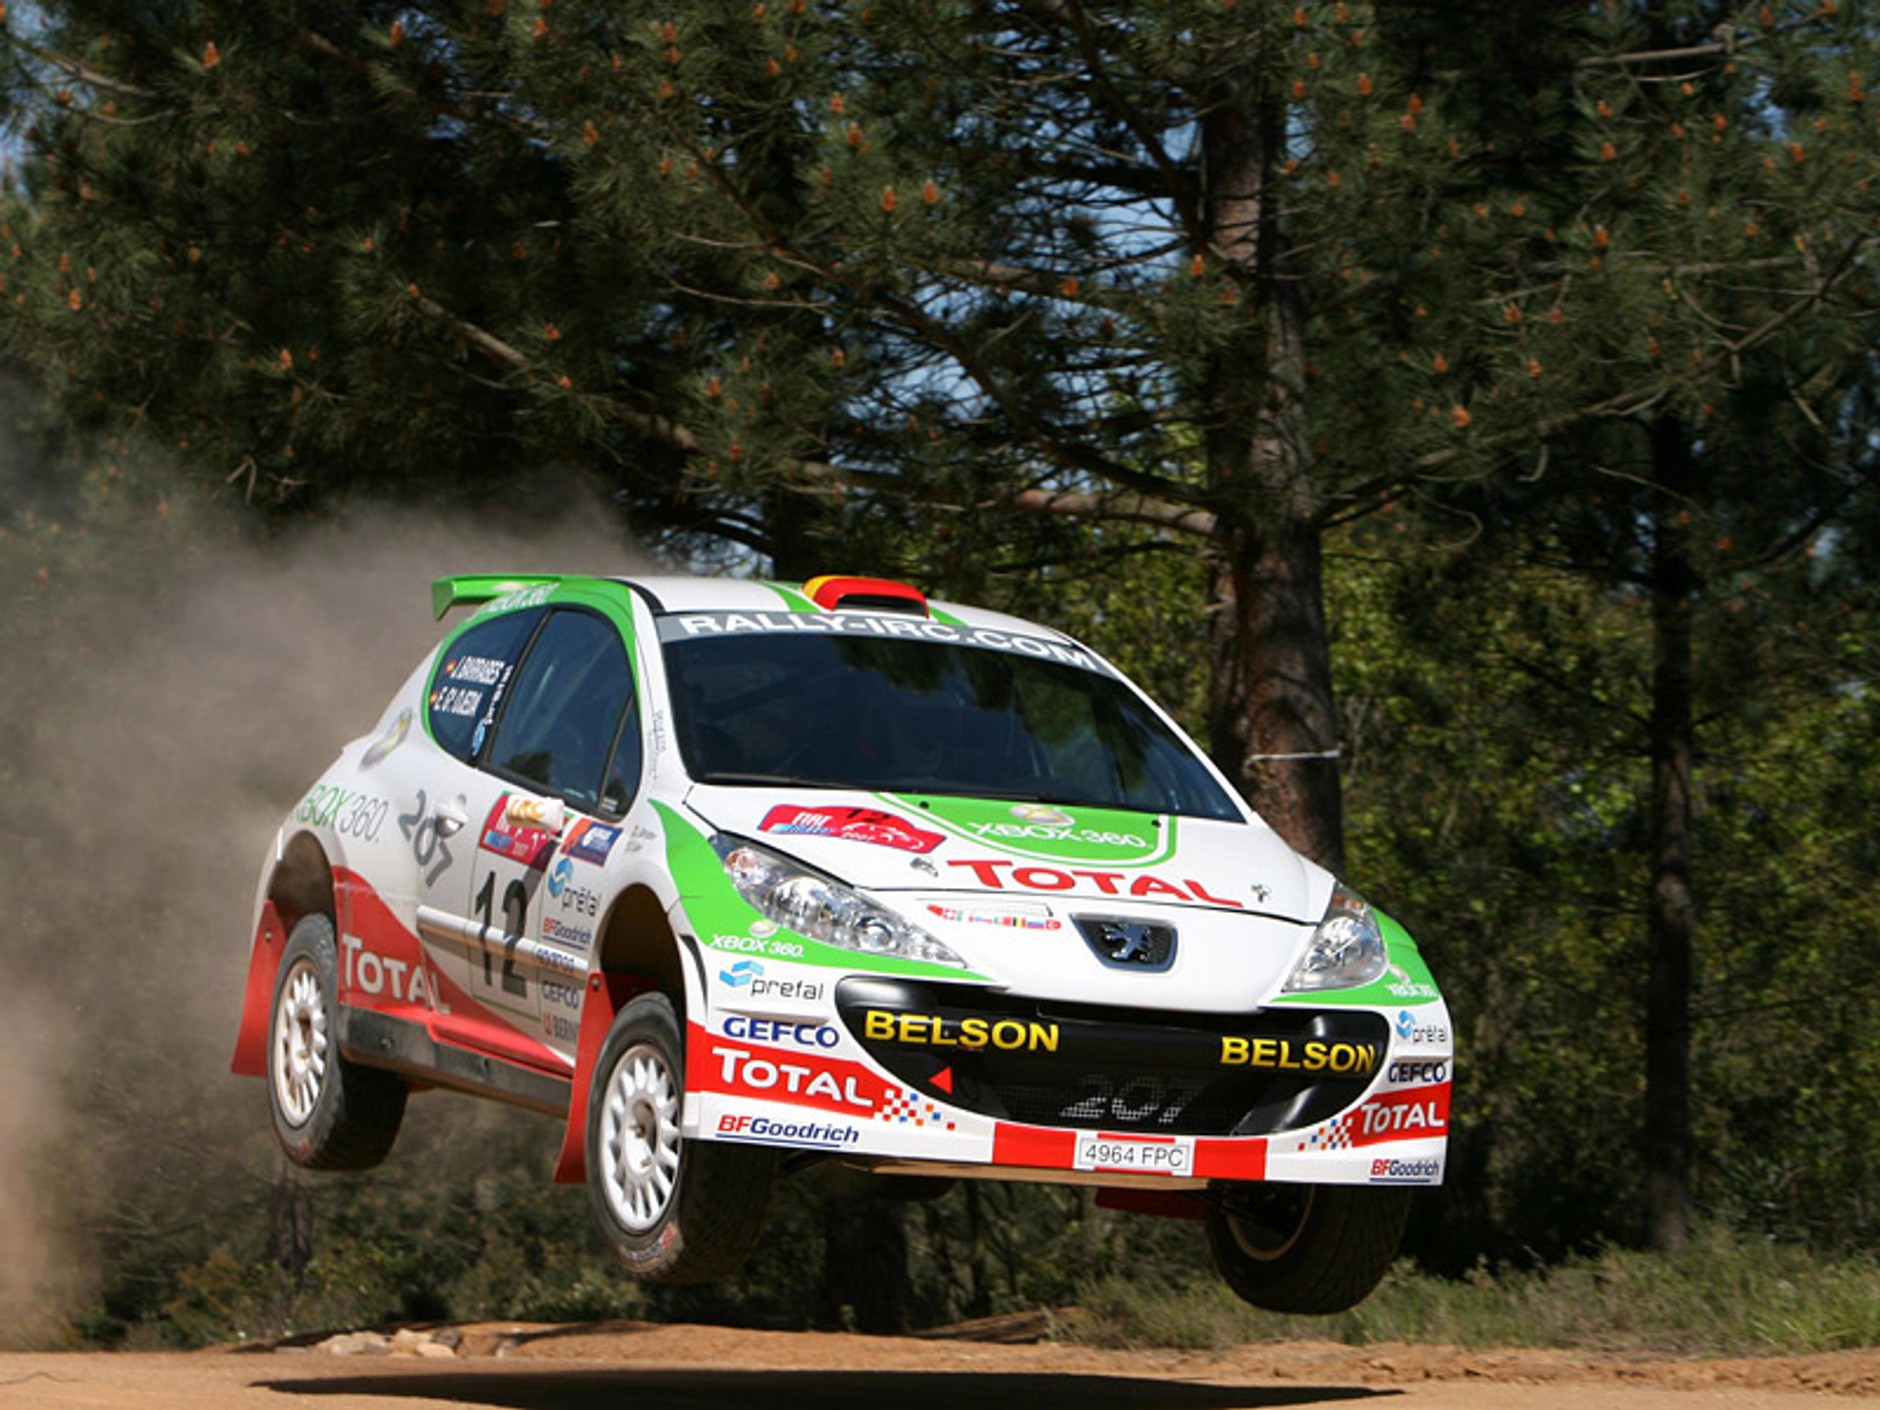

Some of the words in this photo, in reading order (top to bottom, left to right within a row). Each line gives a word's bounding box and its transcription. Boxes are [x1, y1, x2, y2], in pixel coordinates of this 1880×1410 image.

[680, 612, 1099, 672] RALLY-IRC.COM
[397, 789, 454, 888] 207
[967, 821, 1081, 841] XBOX
[1080, 832, 1147, 849] 360
[946, 859, 1244, 908] TOTAL
[474, 870, 528, 999] 12
[710, 934, 769, 953] XBOX
[768, 941, 804, 957] 360
[342, 932, 451, 1015] TOTAL
[723, 1017, 840, 1048] GEFCO
[865, 1010, 1060, 1053] BELSON
[1220, 1036, 1377, 1074] BELSON
[1389, 1061, 1447, 1084] GEFCO
[711, 1046, 873, 1108] TOTAL
[1058, 1074, 1203, 1124] 207
[717, 1115, 859, 1143] BFGoodrich
[1361, 1101, 1446, 1136] TOTAL
[1085, 1143, 1136, 1165] 4964
[1141, 1146, 1184, 1167] FPC
[1371, 1158, 1440, 1177] BFGoodrich
